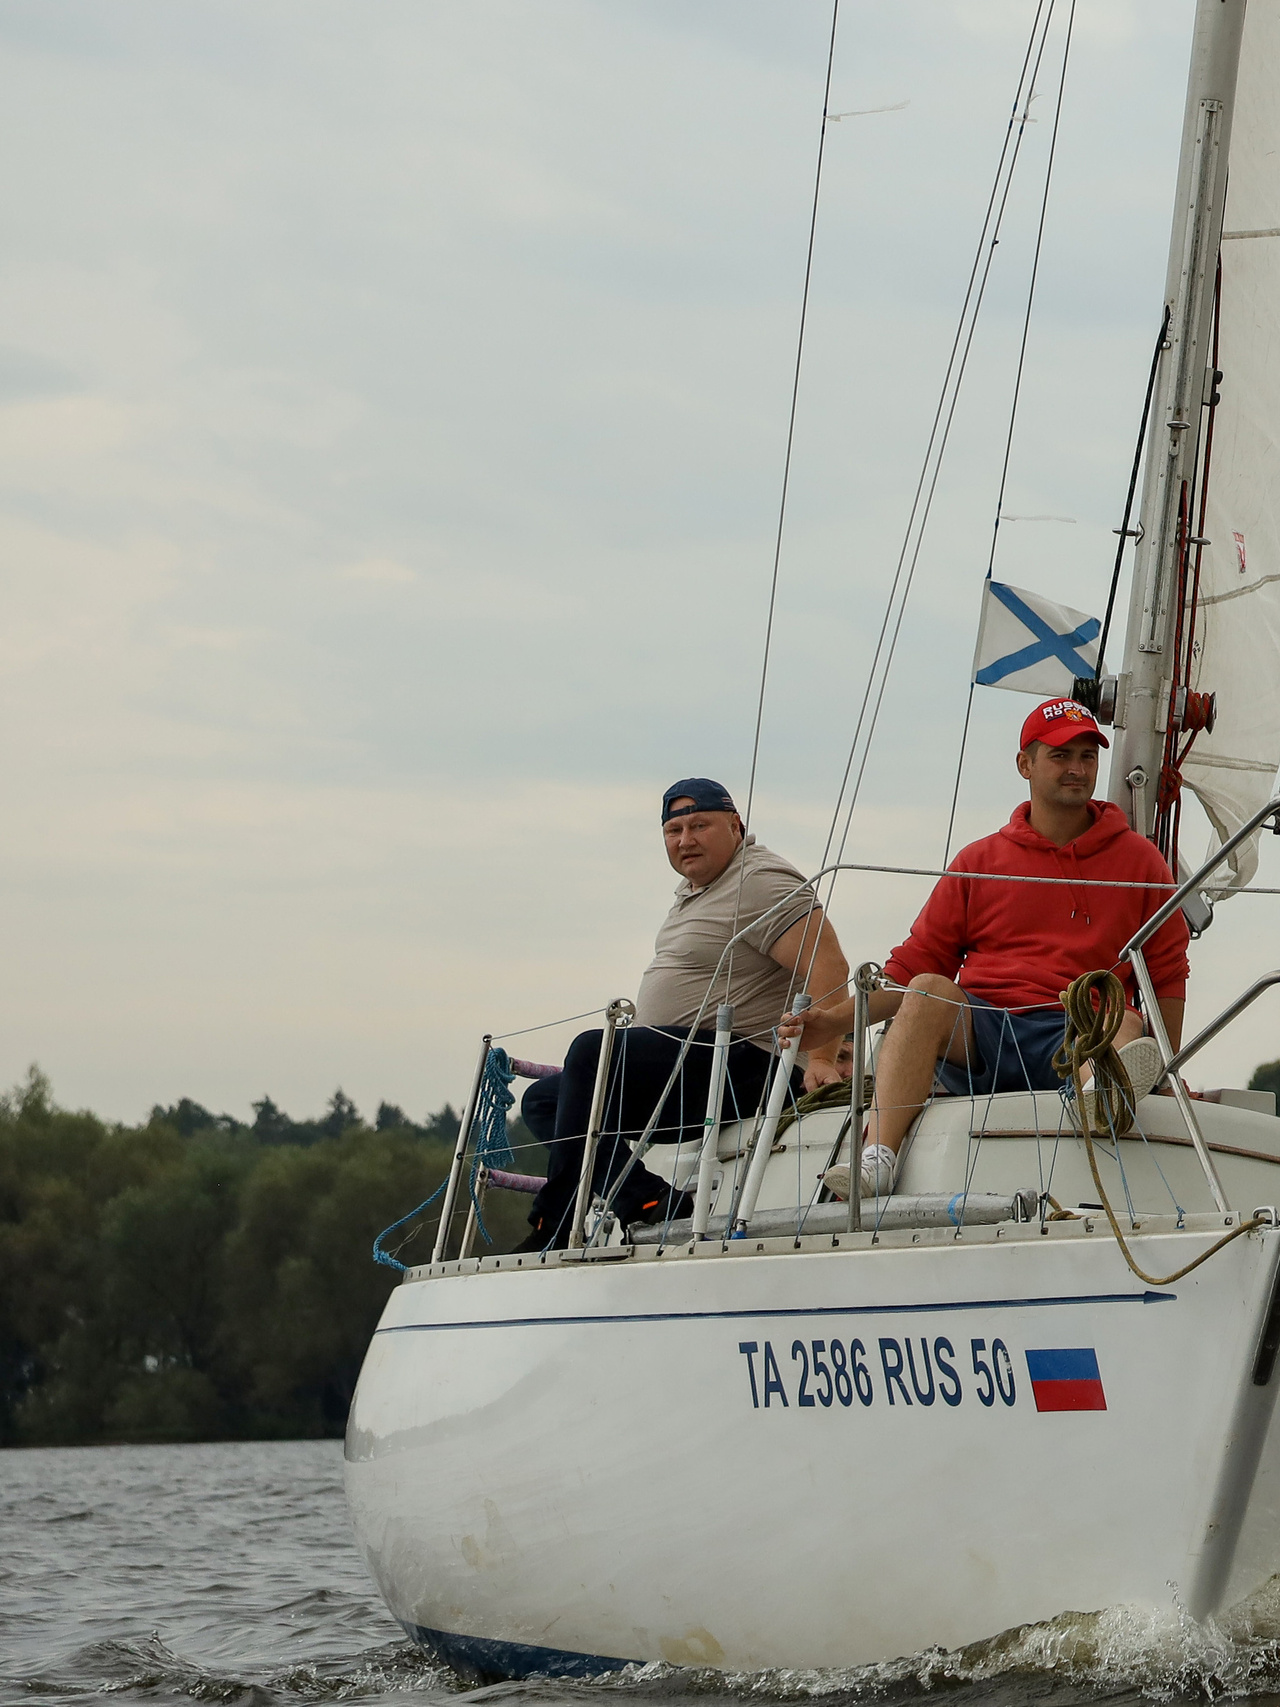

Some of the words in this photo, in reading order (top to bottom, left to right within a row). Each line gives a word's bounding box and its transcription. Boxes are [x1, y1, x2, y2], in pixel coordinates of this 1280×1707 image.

[738, 1341, 789, 1408] TA
[791, 1338, 873, 1408] 2586
[878, 1336, 963, 1406] RUS
[970, 1337, 1016, 1407] 50
